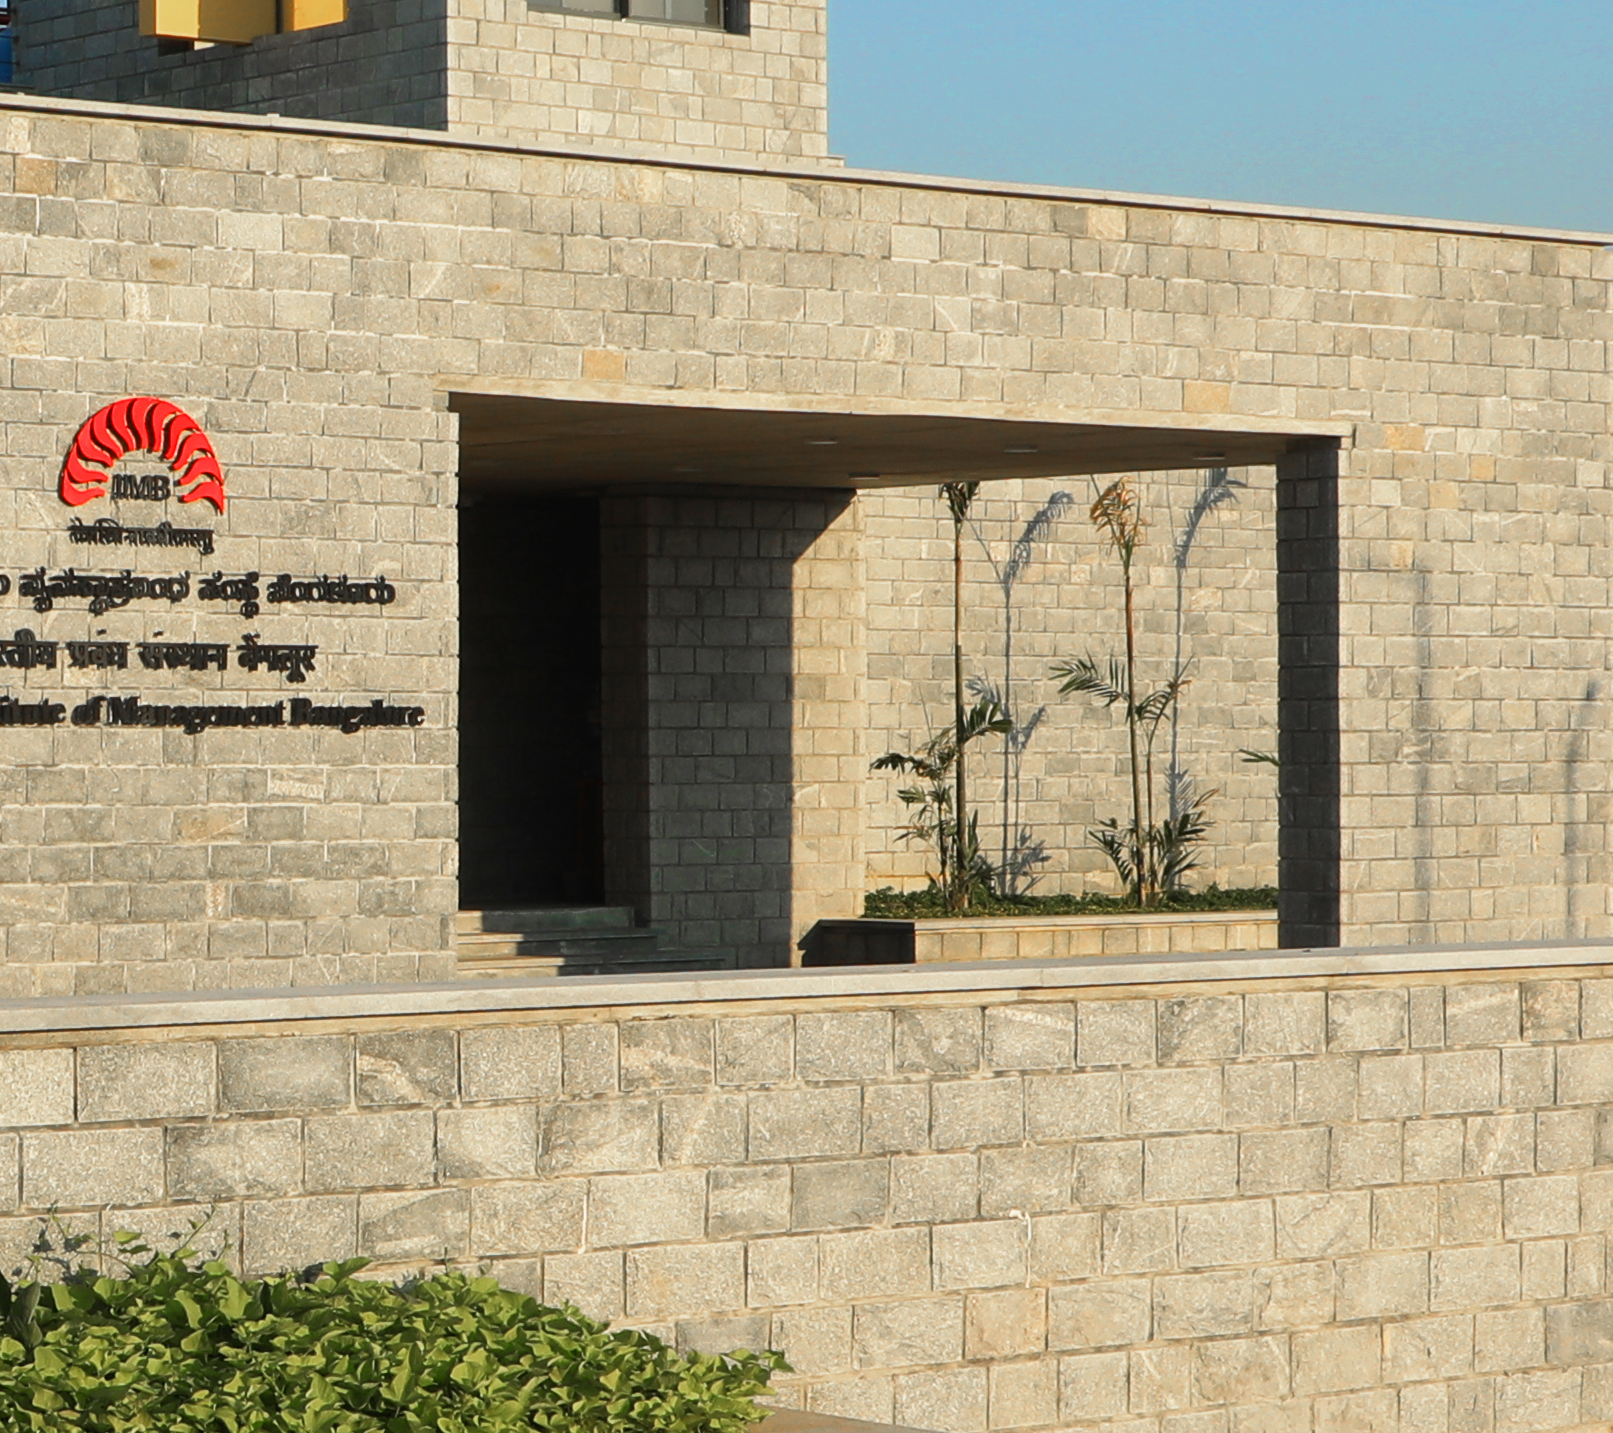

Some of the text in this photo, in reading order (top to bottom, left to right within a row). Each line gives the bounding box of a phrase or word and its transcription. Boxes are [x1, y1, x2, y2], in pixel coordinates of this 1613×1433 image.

[111, 473, 171, 501] IIMB
[71, 695, 108, 725] of
[108, 696, 285, 735] Management
[289, 698, 425, 735] Bangalore
